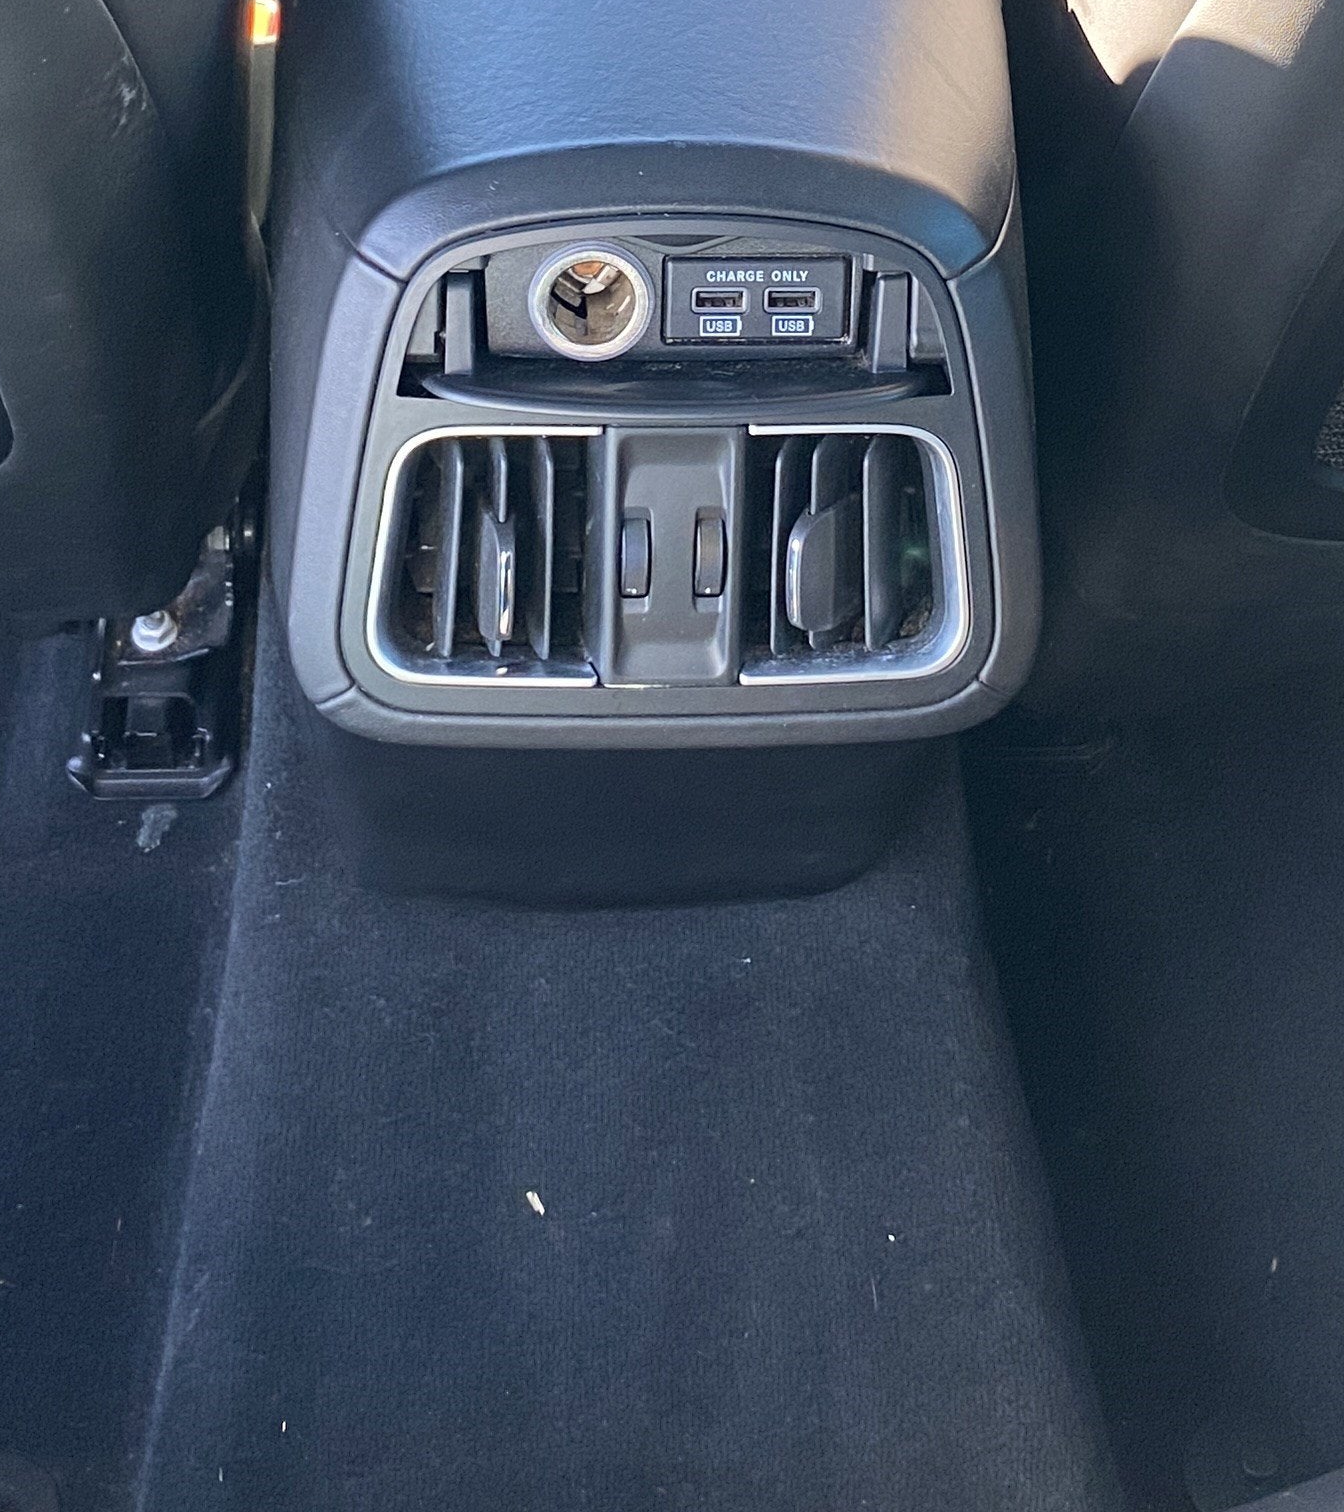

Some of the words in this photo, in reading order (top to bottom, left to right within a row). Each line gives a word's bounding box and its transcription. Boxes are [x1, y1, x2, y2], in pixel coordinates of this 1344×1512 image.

[706, 270, 764, 282] CHARGE
[771, 270, 809, 282] ONLY
[705, 320, 733, 332] USB
[778, 319, 805, 332] USB
